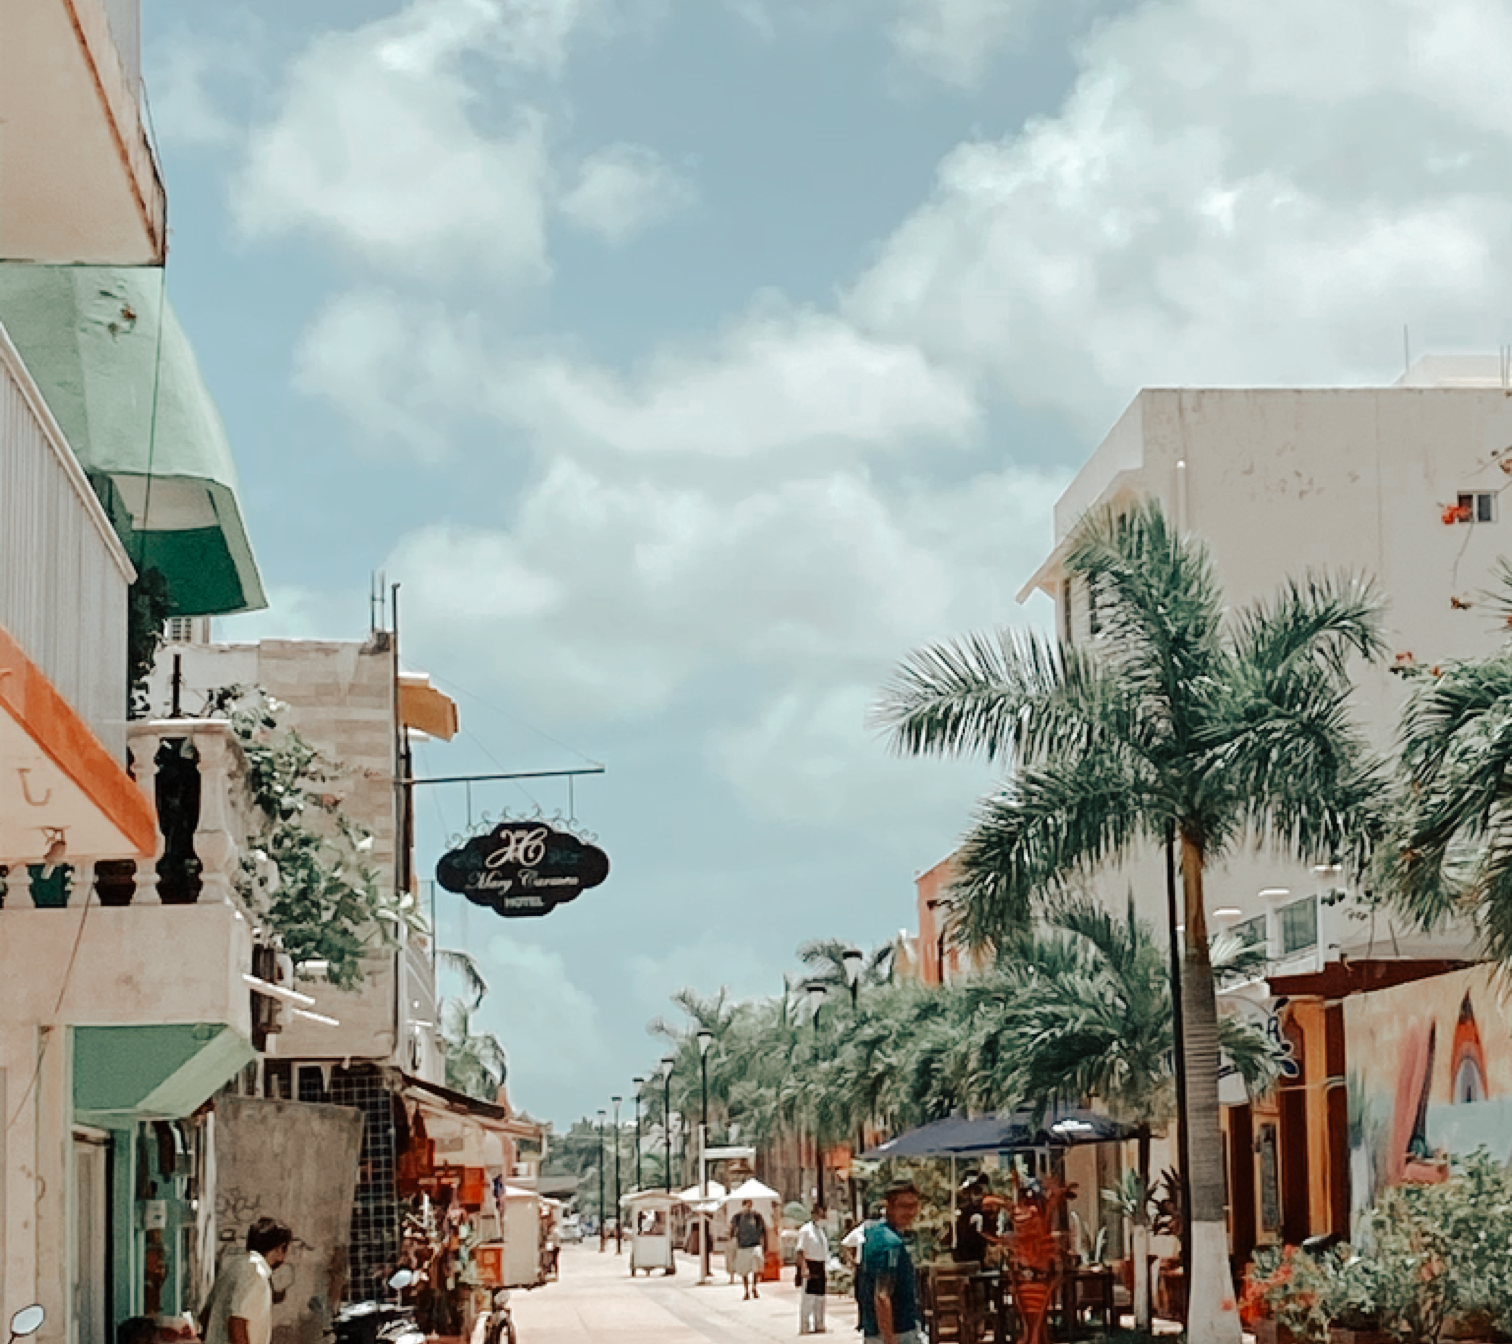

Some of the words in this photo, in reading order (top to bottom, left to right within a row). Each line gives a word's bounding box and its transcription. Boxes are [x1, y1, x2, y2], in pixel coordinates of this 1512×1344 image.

[464, 870, 513, 896] Mary
[518, 868, 579, 888] Carmen
[504, 896, 546, 909] HOTEL
